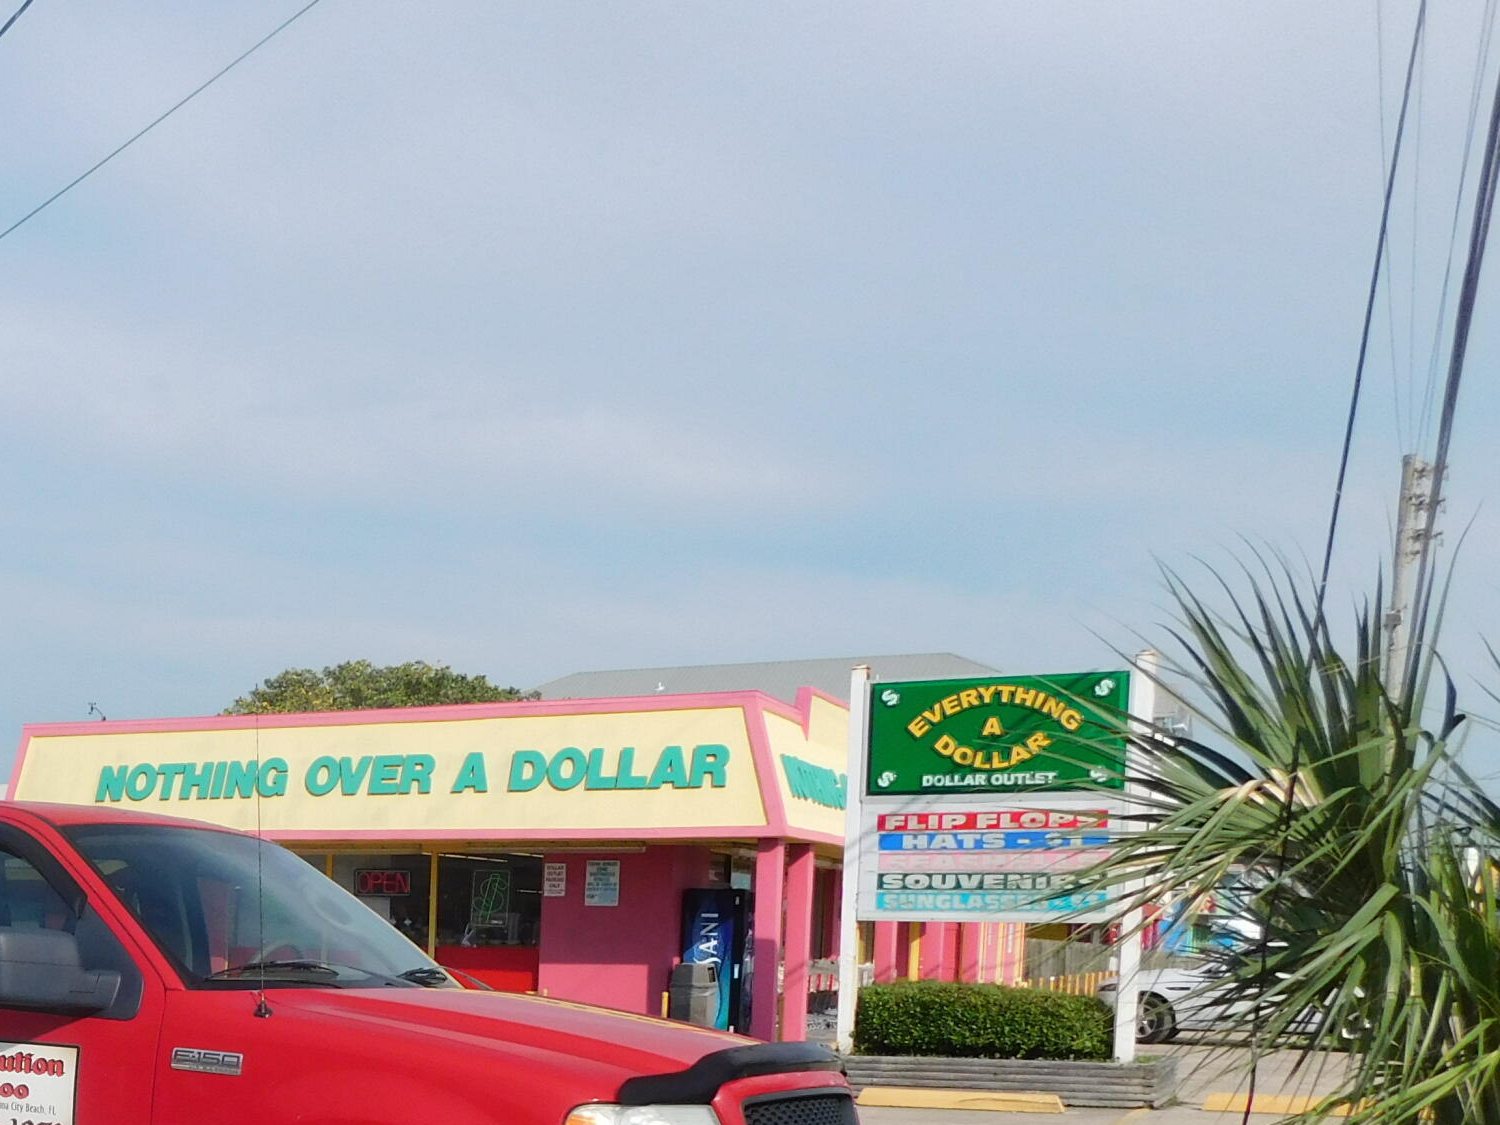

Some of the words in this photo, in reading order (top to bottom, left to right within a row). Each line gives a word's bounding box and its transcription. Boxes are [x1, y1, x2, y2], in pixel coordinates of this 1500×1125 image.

[907, 685, 1085, 738] EVERYTHING
[981, 717, 1004, 736] A
[933, 731, 1053, 769] DOLLAR
[95, 757, 289, 802] NOTHING
[305, 754, 436, 796] OVER
[450, 752, 488, 793] A
[507, 744, 731, 792] DOLLAR
[922, 774, 988, 788] DOLLAR
[992, 771, 1058, 786] OUTLET
[885, 814, 967, 830] FLIP
[976, 812, 1099, 830] FLOPS
[902, 833, 1005, 849] HATS
[358, 871, 409, 894] OPEN
[11, 1101, 23, 1113] City
